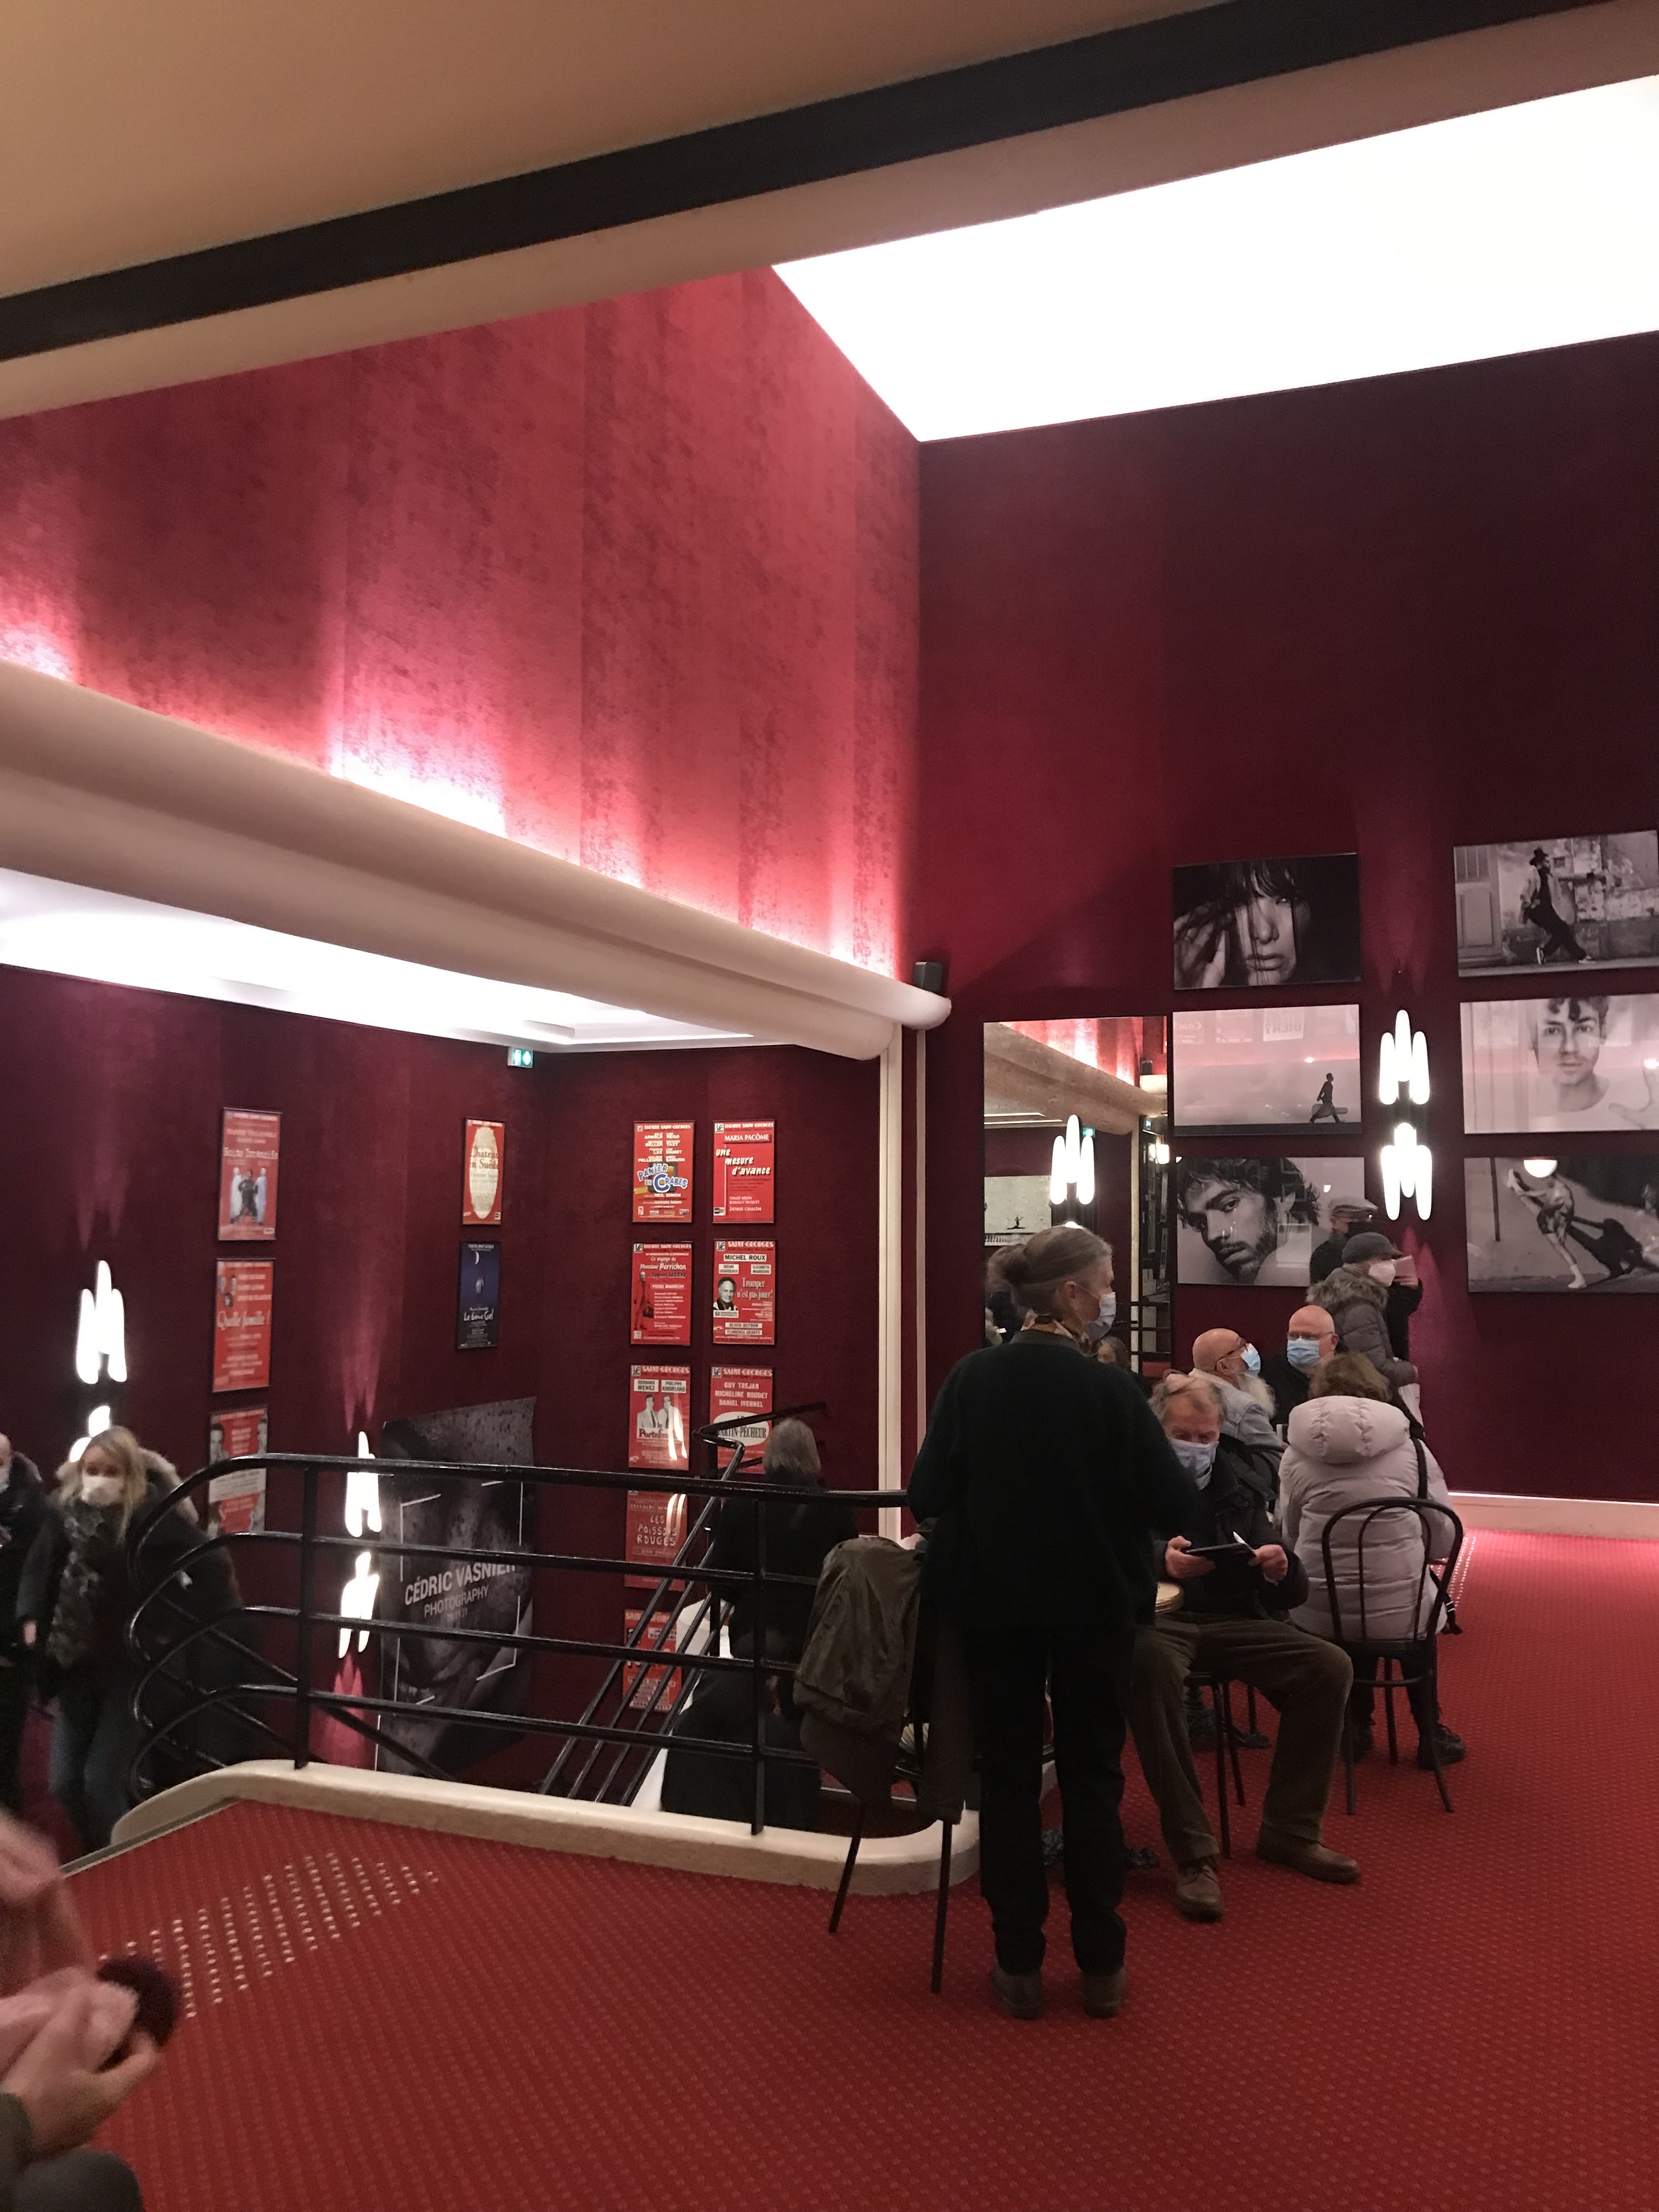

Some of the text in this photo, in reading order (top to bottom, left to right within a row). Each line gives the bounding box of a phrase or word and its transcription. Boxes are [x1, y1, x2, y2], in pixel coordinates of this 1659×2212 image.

[744, 1132, 769, 1141] PACÔME
[725, 1156, 753, 1165] mesure
[637, 1164, 668, 1181] PANIER
[732, 1166, 770, 1175] d'avance
[653, 1173, 688, 1193] CRABES
[659, 1263, 686, 1271] Perrichon
[742, 1277, 765, 1290] Tromper
[724, 1368, 772, 1377] SAINT-GEORGES
[650, 1515, 665, 1524] LES
[637, 1534, 676, 1546] ROUGES
[405, 1571, 453, 1605] CÉDRIC
[424, 1584, 489, 1618] PHOTOGRAPHY
